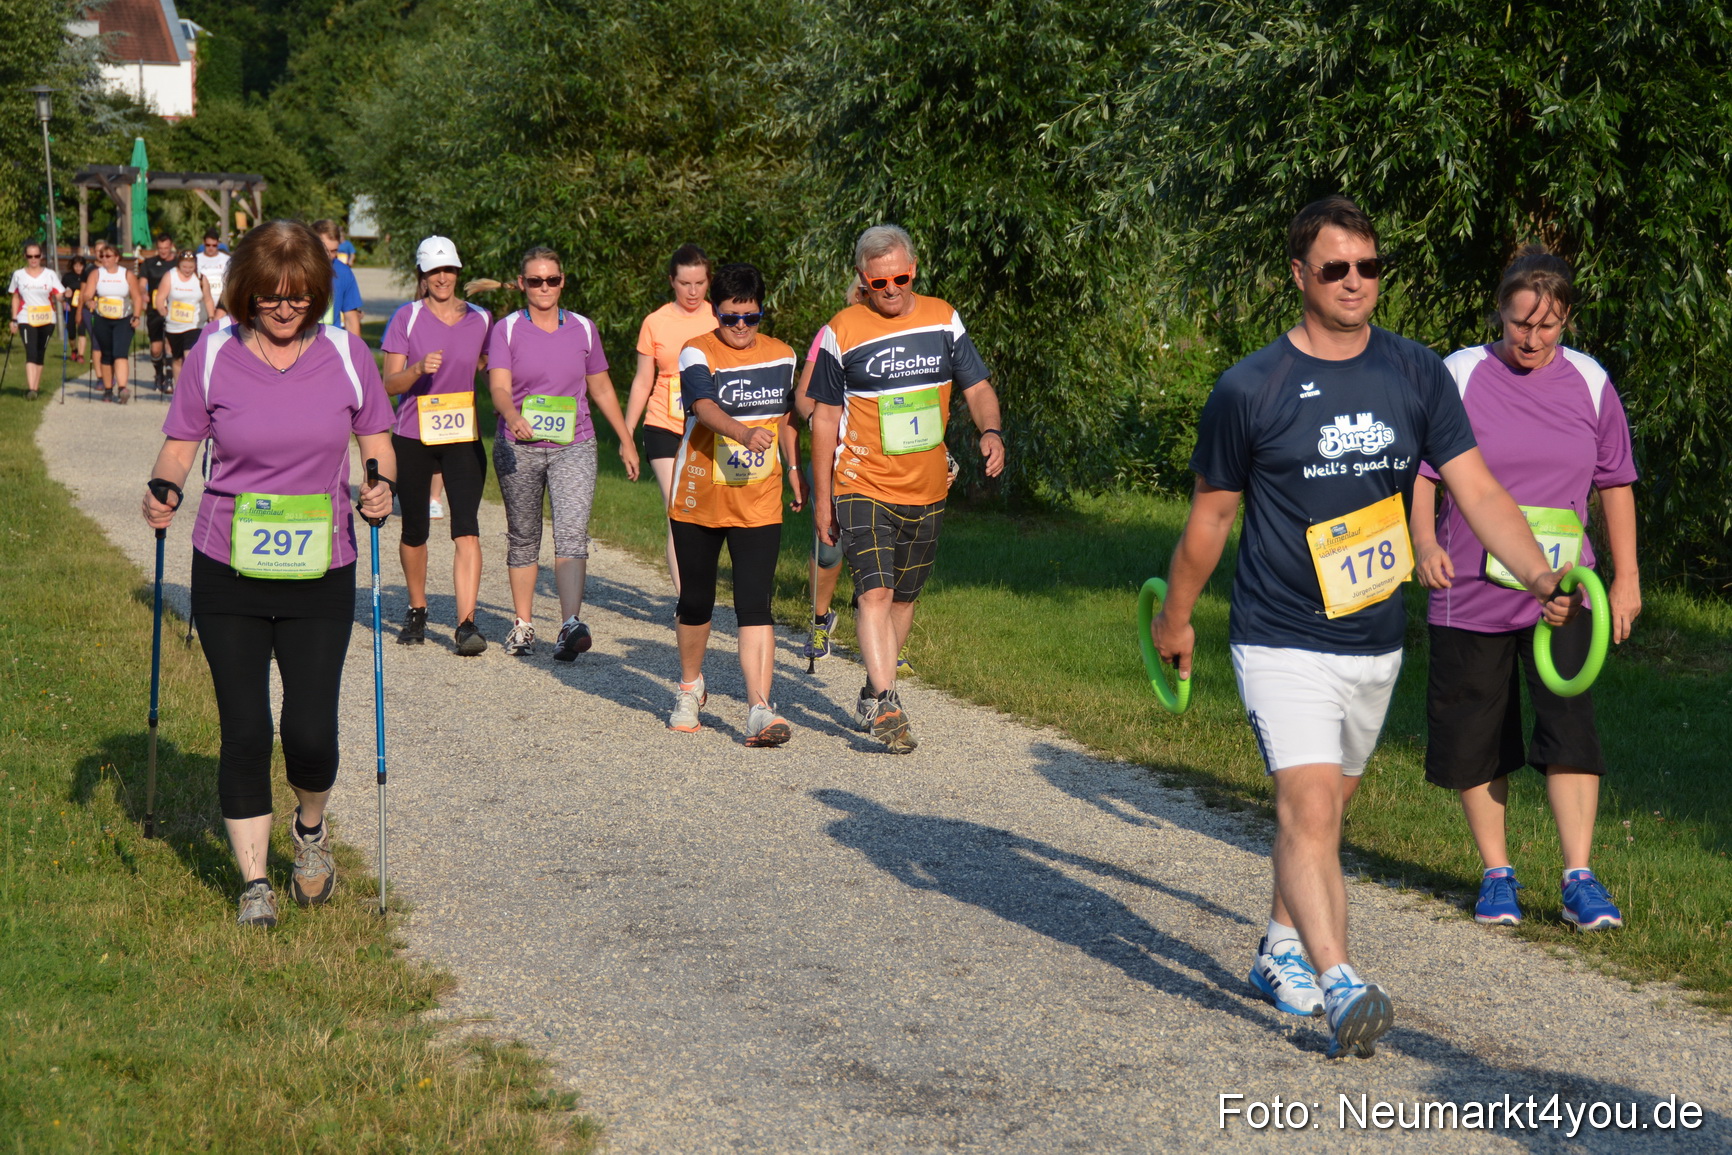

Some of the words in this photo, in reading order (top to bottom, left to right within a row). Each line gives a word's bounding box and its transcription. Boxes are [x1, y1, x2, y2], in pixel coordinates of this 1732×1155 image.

[881, 355, 942, 374] Fischer
[888, 367, 940, 379] AUTOMOBILE
[732, 386, 784, 402] Fischer
[737, 398, 783, 408] AUTOMOBILE
[431, 412, 465, 430] 320
[532, 414, 566, 432] 299
[909, 415, 919, 435] 1
[1318, 421, 1395, 459] Burgis
[726, 450, 765, 469] 438
[1303, 461, 1347, 479] Weil's
[1352, 455, 1389, 477] guad
[251, 528, 313, 556] 297
[1340, 540, 1396, 585] 178
